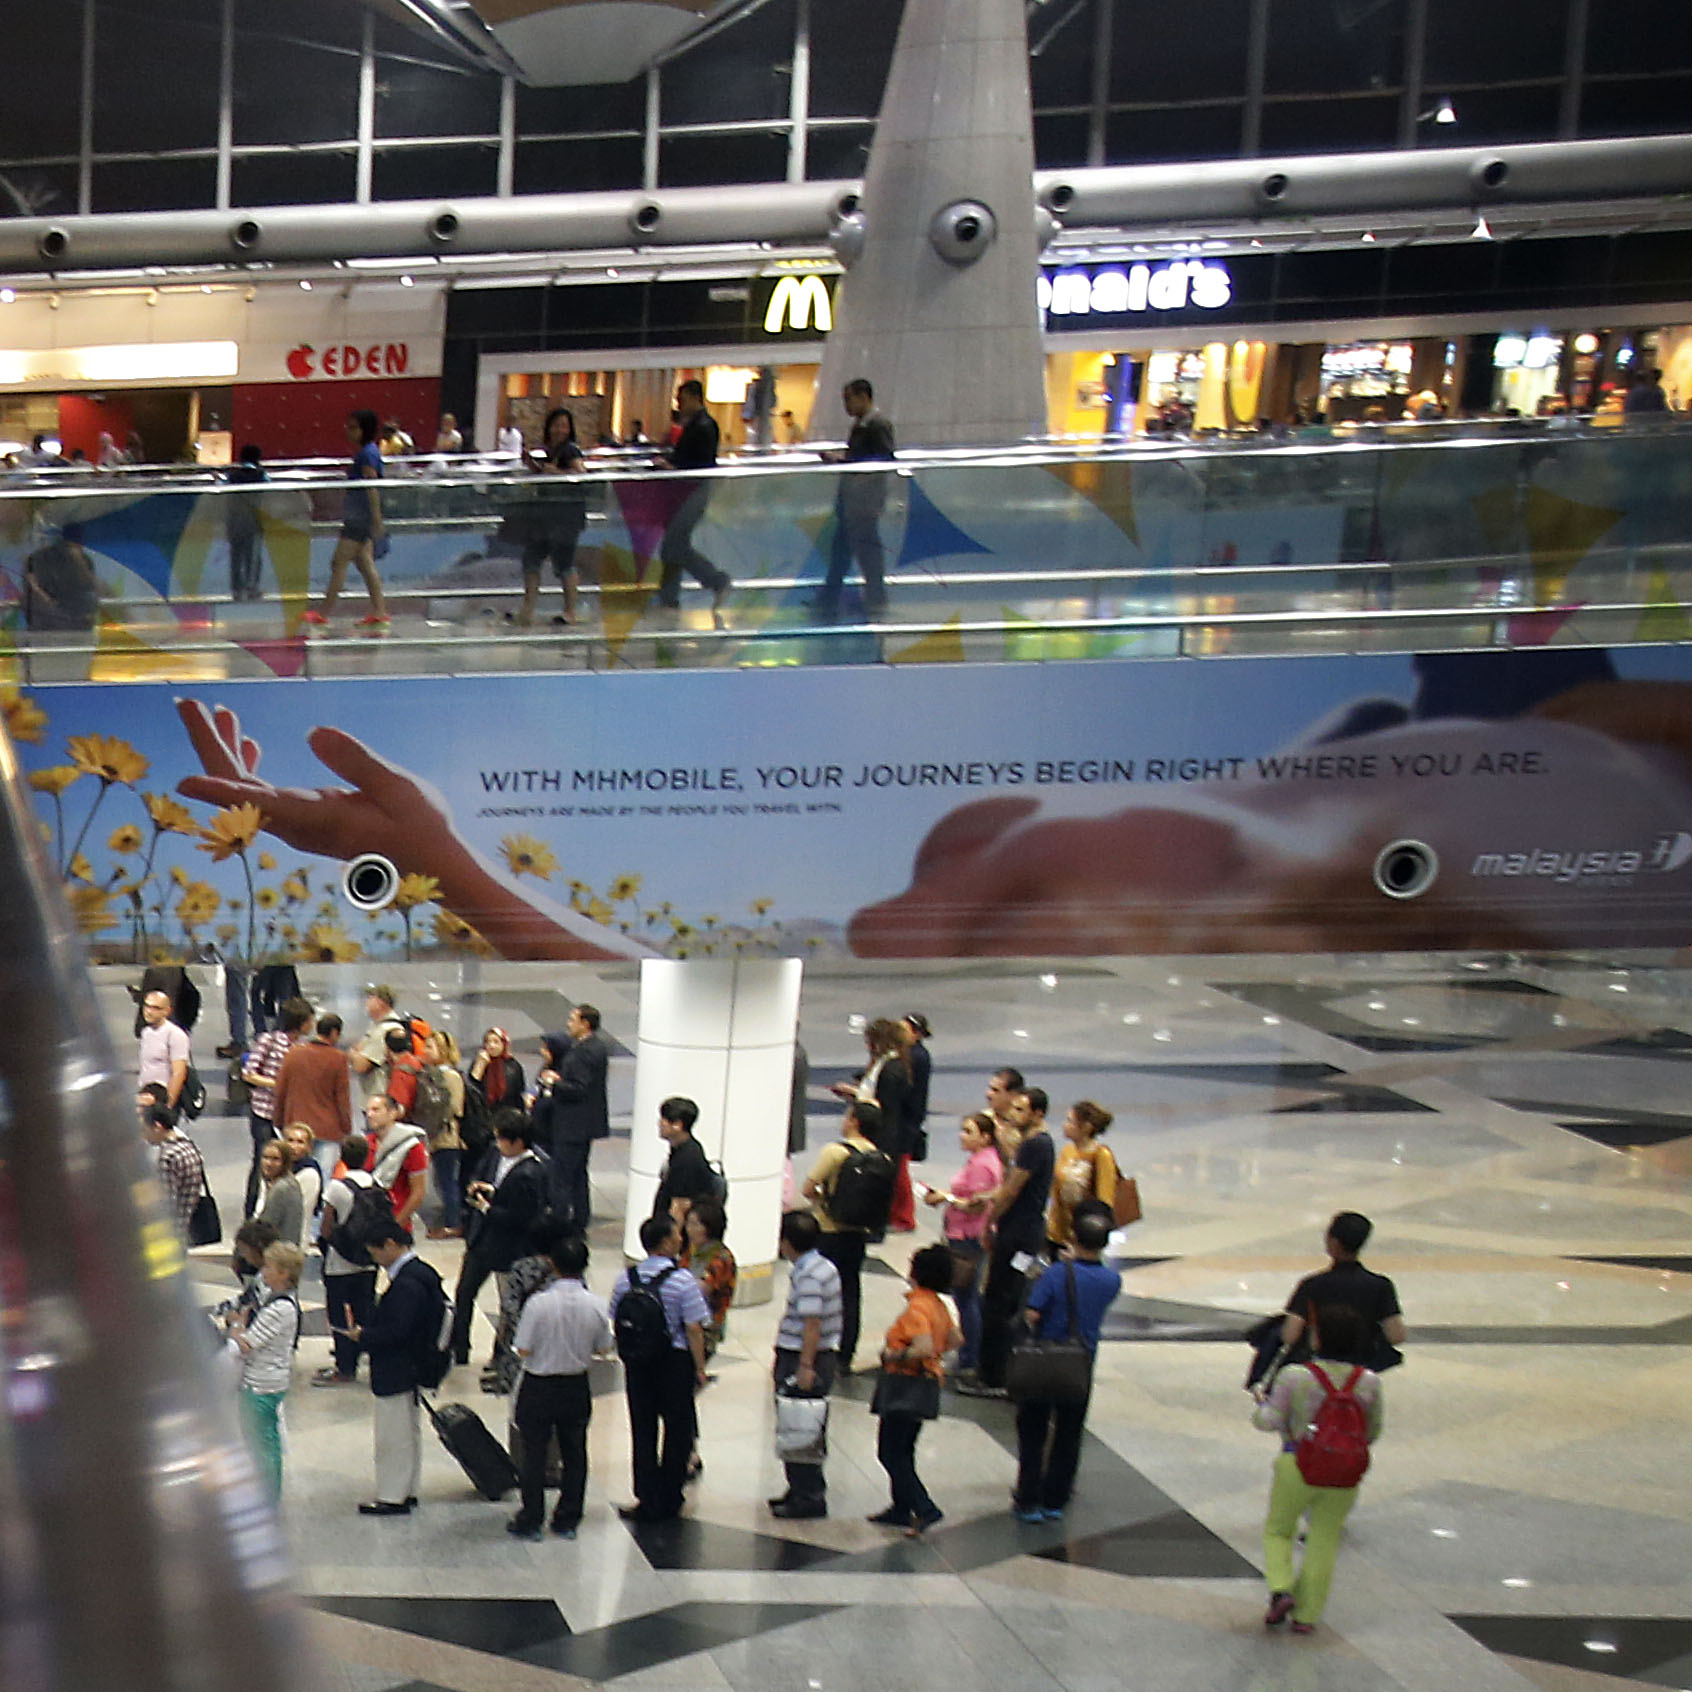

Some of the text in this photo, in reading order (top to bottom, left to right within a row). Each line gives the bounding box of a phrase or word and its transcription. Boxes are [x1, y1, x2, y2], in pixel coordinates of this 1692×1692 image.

[322, 343, 408, 376] EDEN
[480, 751, 1551, 792] WITH MHMOBILE, YOUR JOURNEYS BEGIN RIGHT WHERE YOU ARE.
[1471, 848, 1642, 882] malaysia
